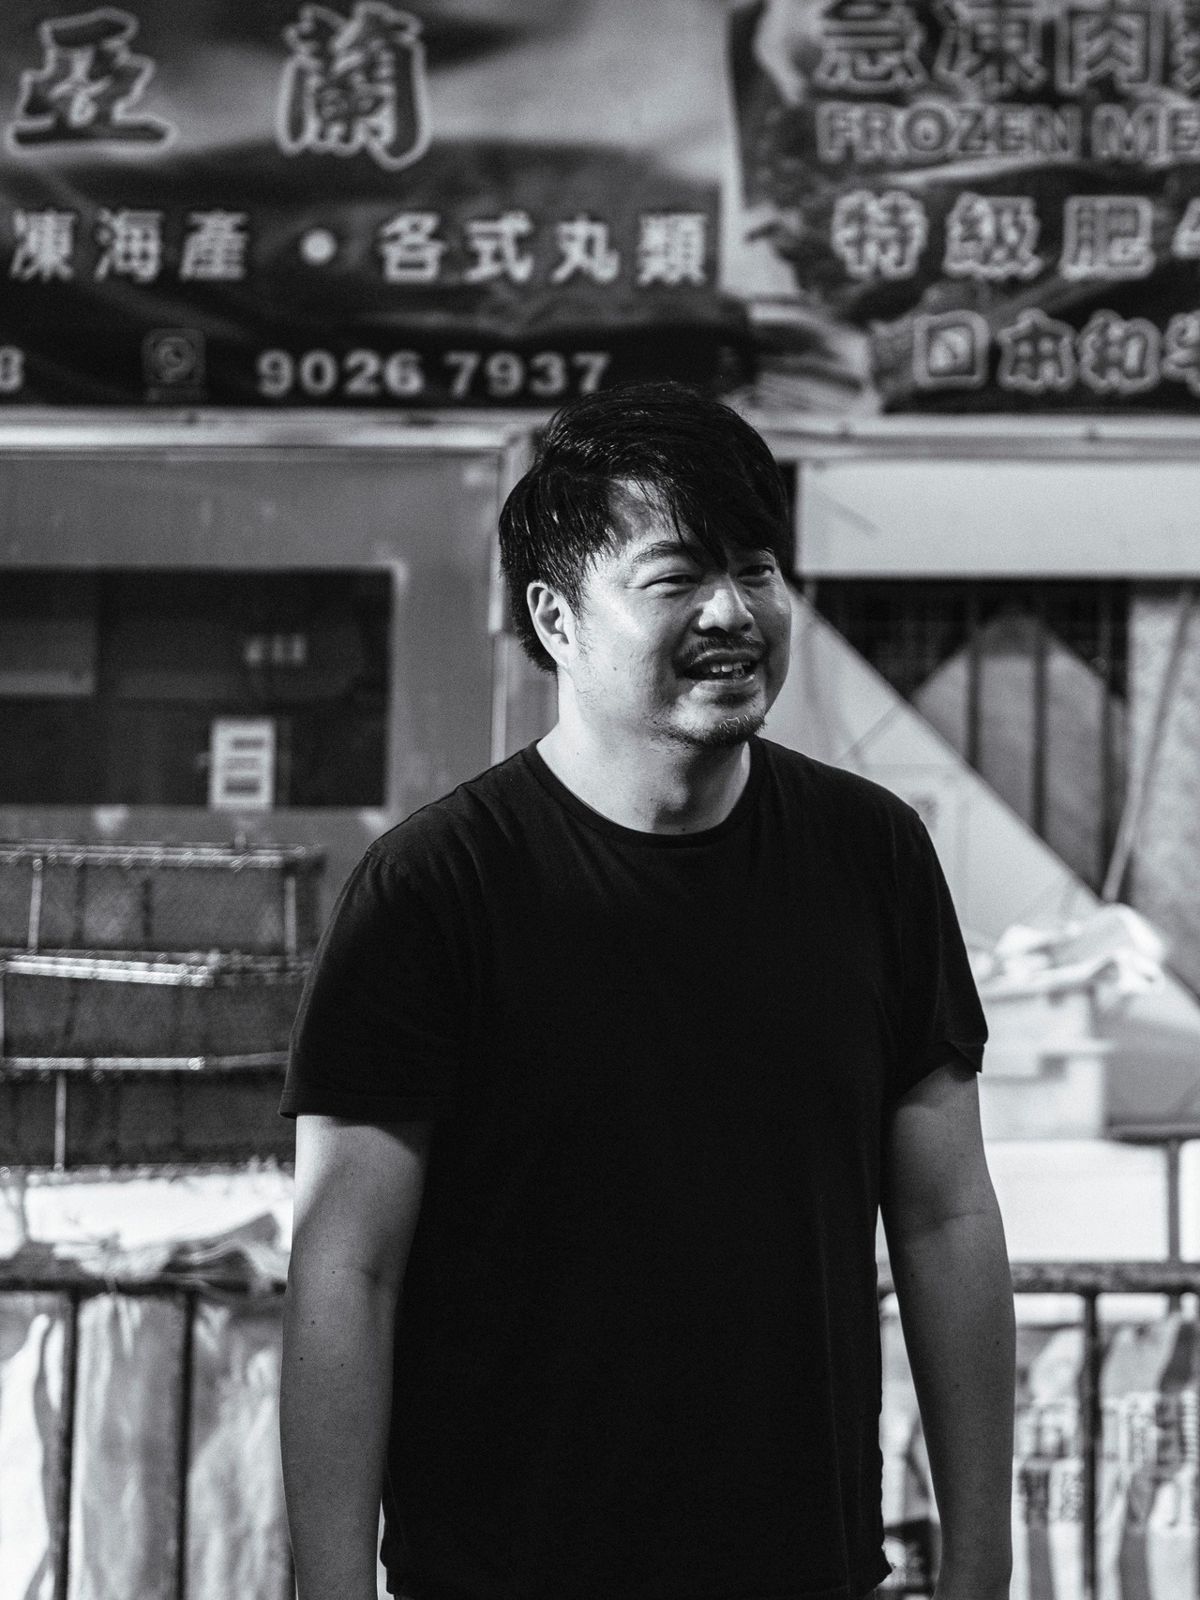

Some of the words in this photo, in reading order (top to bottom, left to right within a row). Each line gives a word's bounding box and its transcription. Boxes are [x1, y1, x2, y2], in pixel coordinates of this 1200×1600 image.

[815, 102, 1083, 164] FROZEN
[256, 349, 426, 396] 9026
[443, 352, 611, 396] 7937
